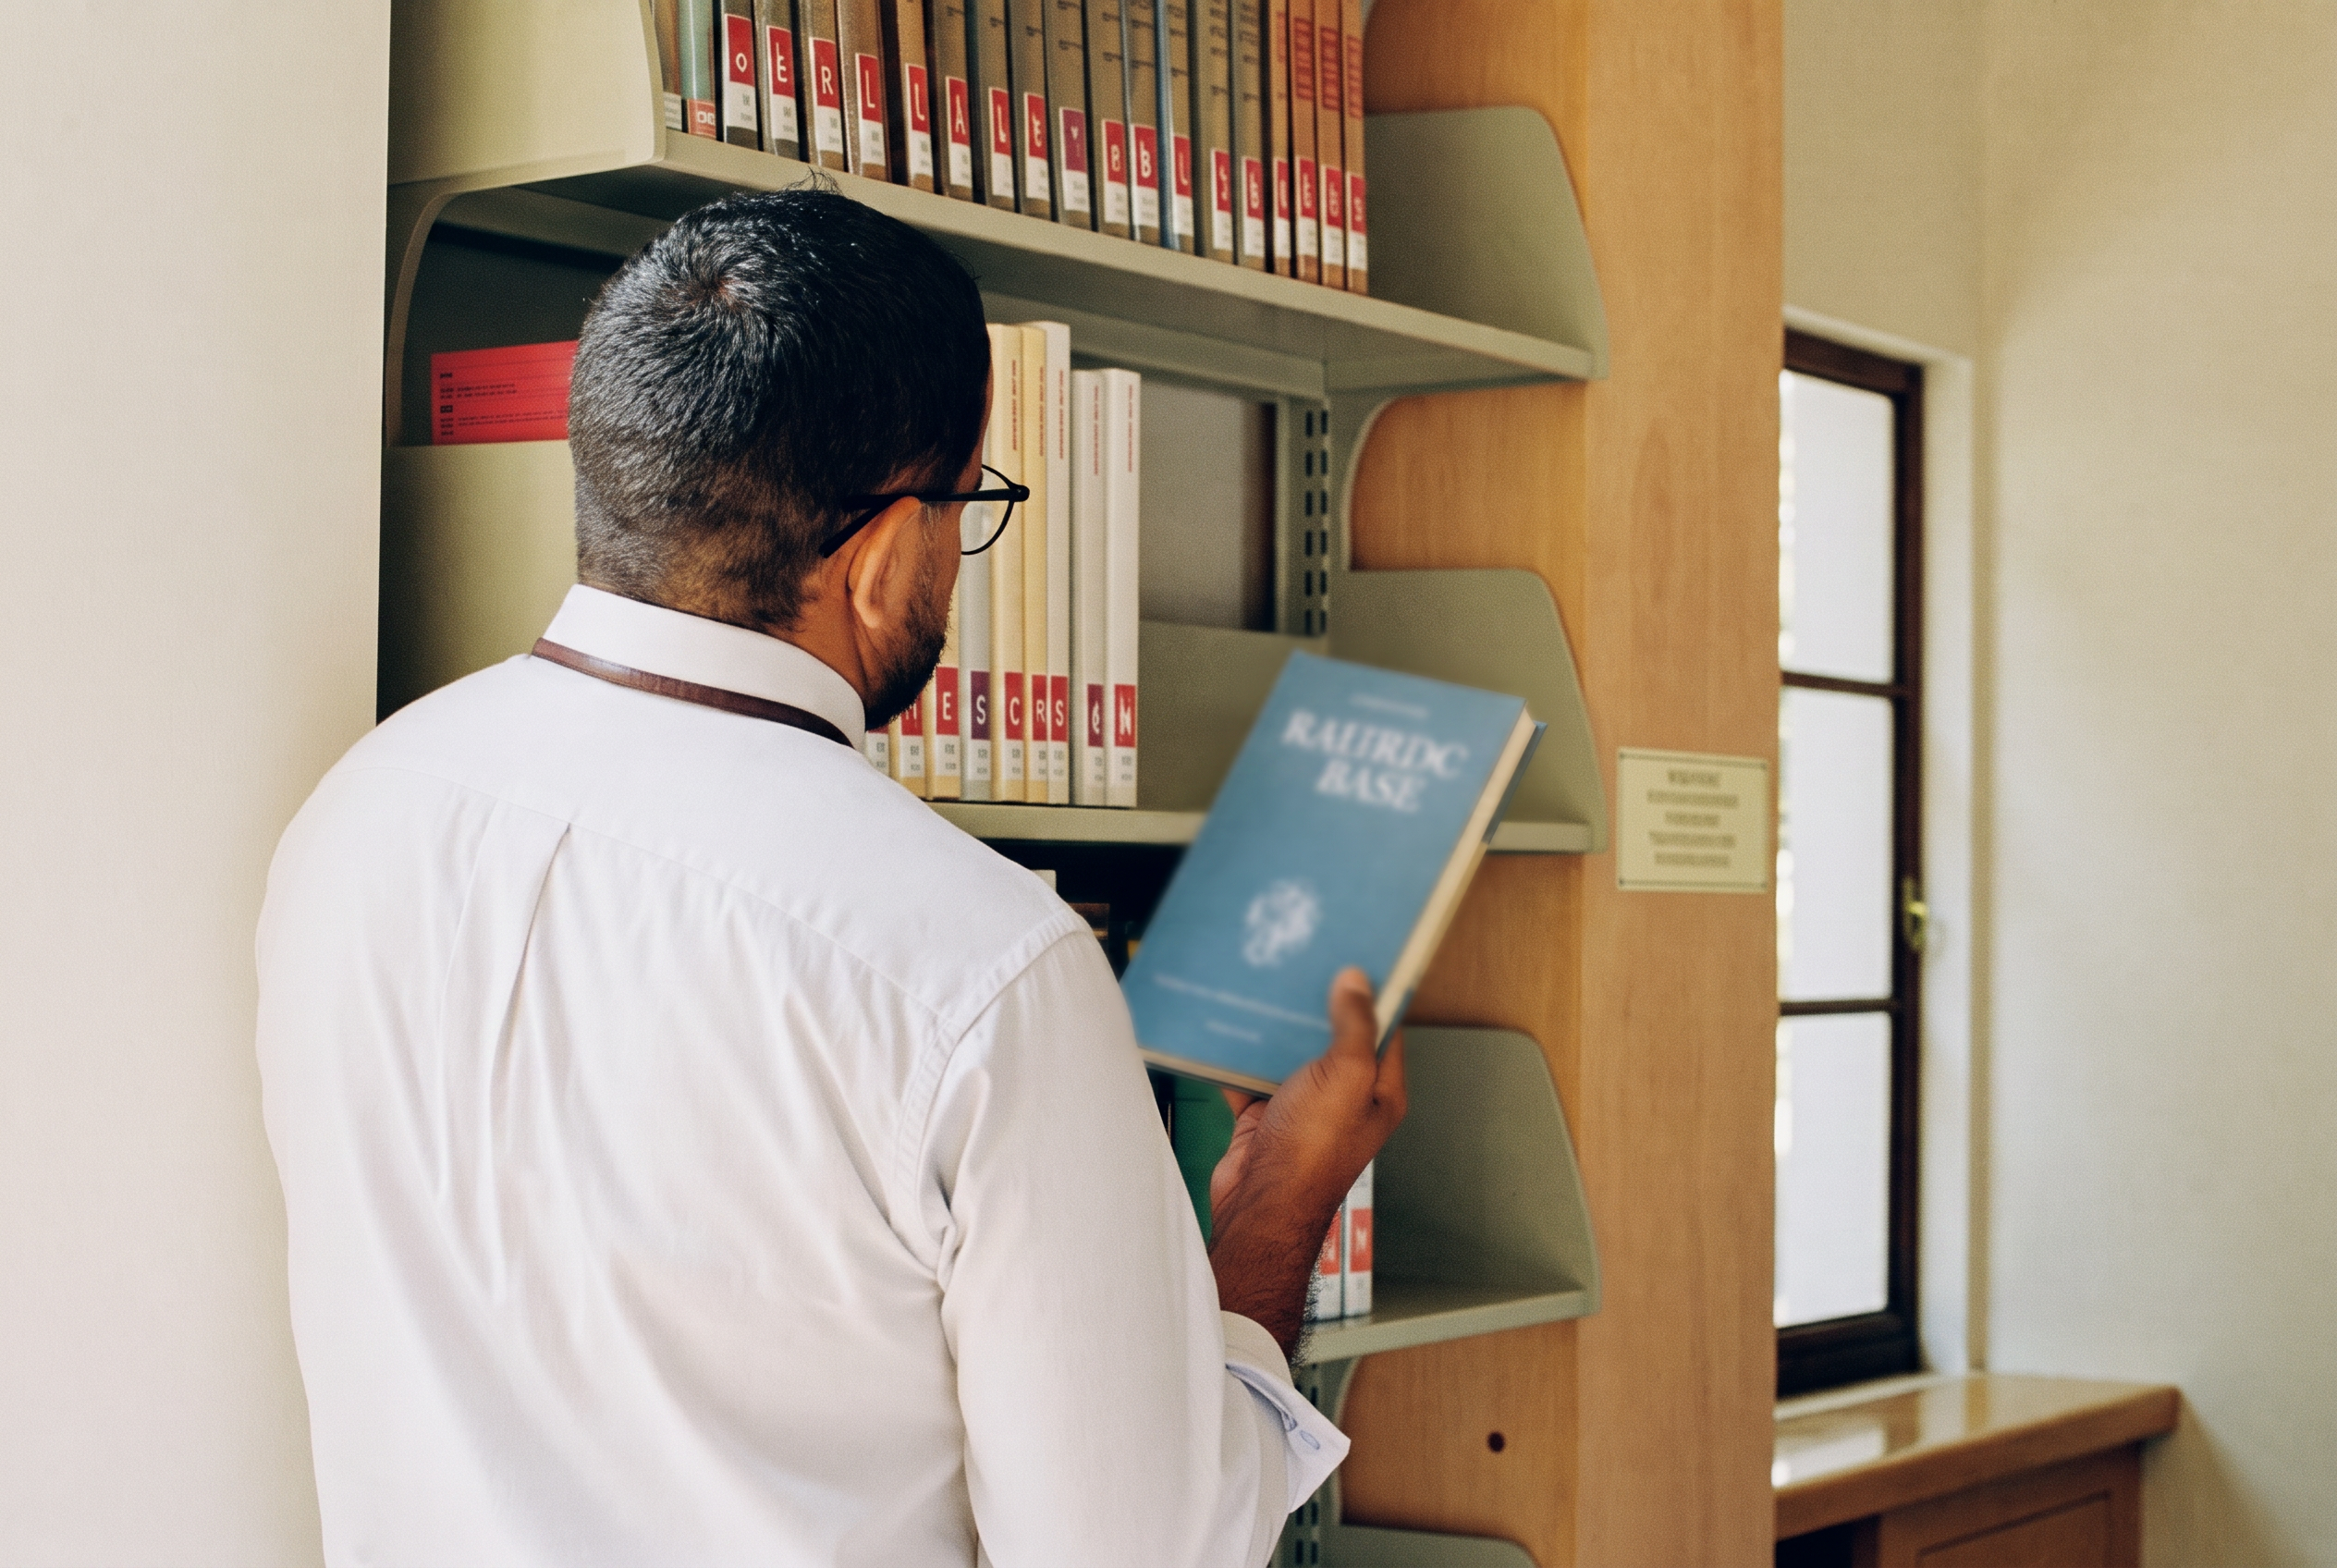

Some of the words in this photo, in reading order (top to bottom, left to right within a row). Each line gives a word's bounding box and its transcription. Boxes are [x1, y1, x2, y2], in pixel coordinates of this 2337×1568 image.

[820, 65, 834, 95] R
[864, 69, 876, 108] L
[913, 82, 925, 121] L
[954, 93, 966, 136] A
[942, 691, 952, 721] E
[975, 694, 986, 726] S
[1009, 696, 1021, 726] C
[1035, 698, 1046, 724] R
[1055, 698, 1064, 728] S
